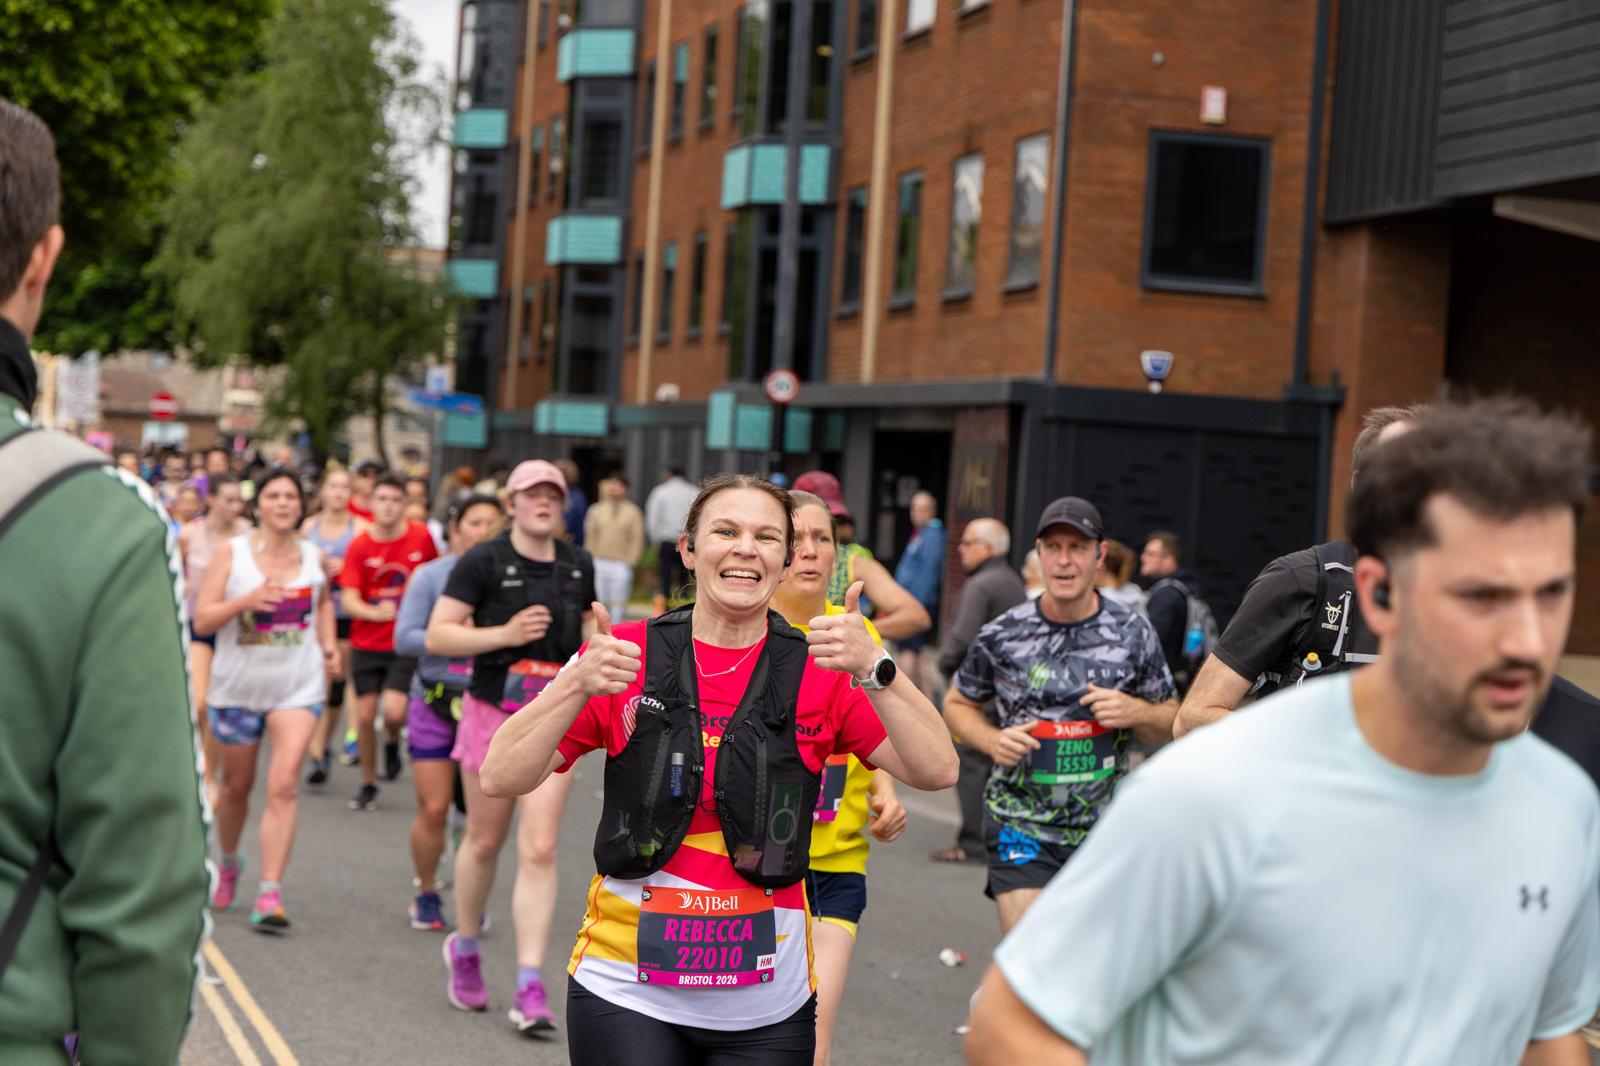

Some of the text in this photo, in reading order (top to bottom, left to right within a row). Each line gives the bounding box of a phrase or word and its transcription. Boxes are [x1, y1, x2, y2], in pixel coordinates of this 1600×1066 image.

[796, 722, 822, 736] our
[702, 731, 720, 748] Re
[1056, 739, 1093, 755] ZENO
[1056, 755, 1096, 772] 15539
[664, 918, 753, 942] REBECCA
[675, 947, 742, 969] 22010
[760, 957, 773, 968] HM
[678, 975, 738, 985] BRISTOL 2026
